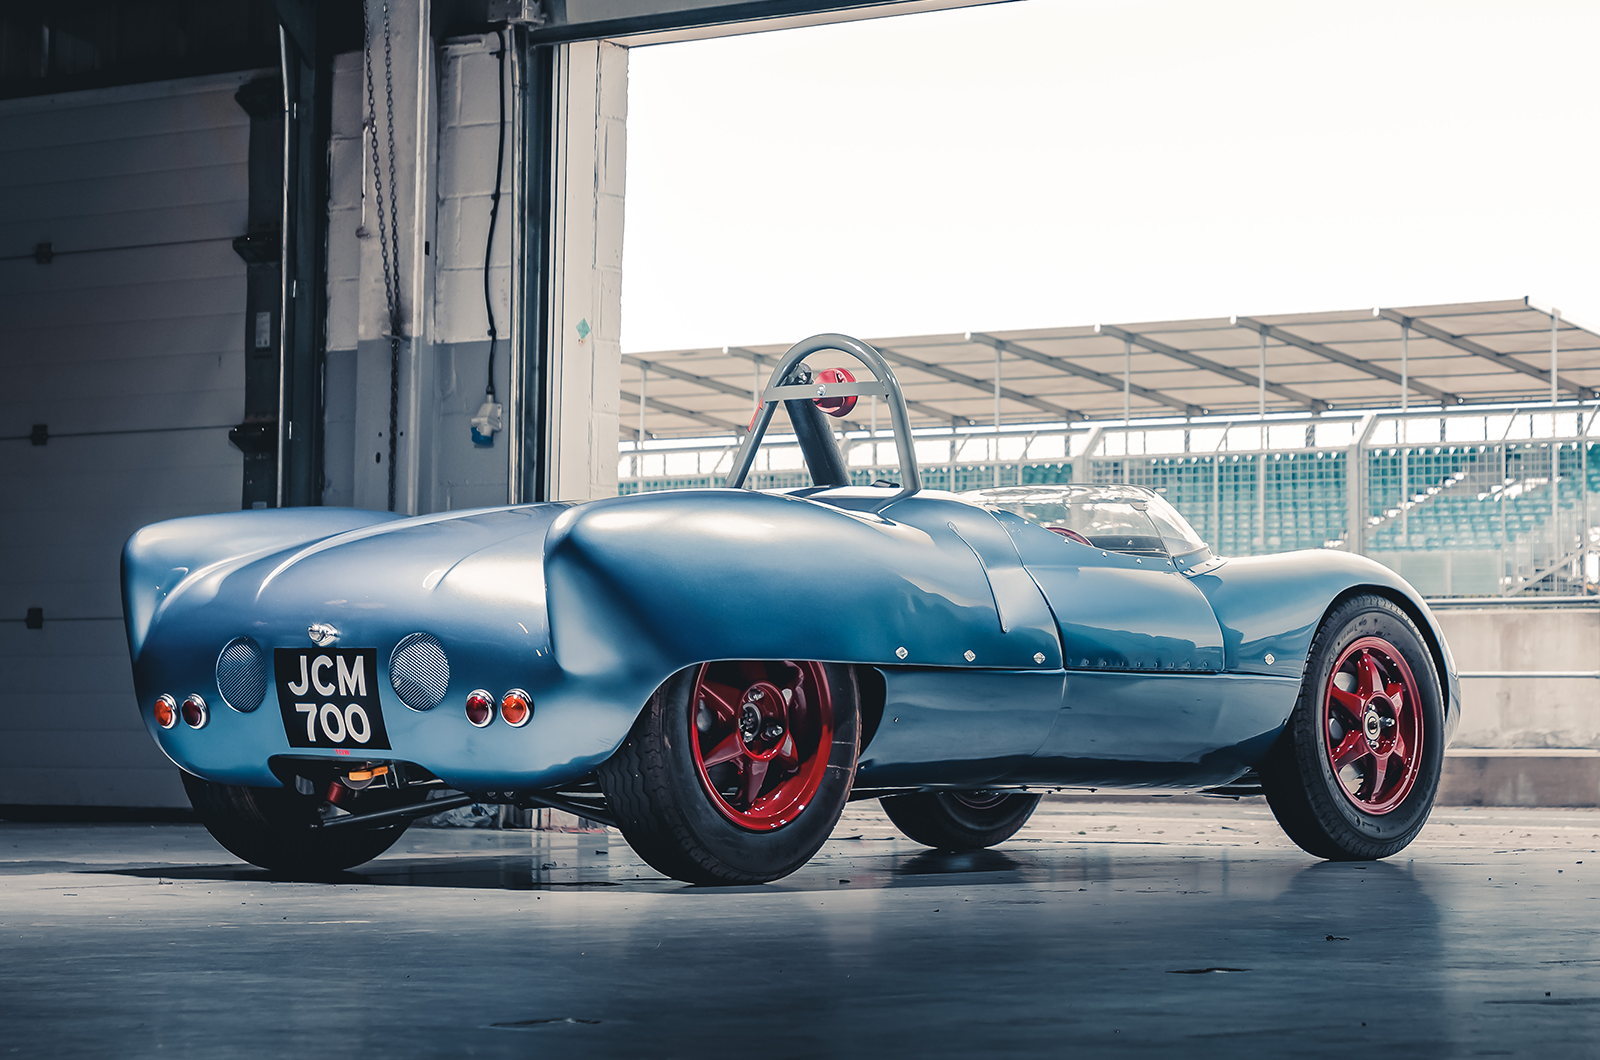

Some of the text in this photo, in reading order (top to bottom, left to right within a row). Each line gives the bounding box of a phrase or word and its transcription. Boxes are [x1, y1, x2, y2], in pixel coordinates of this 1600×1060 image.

[287, 654, 367, 697] JCM
[294, 702, 372, 744] 700
[334, 748, 350, 756] TOW
